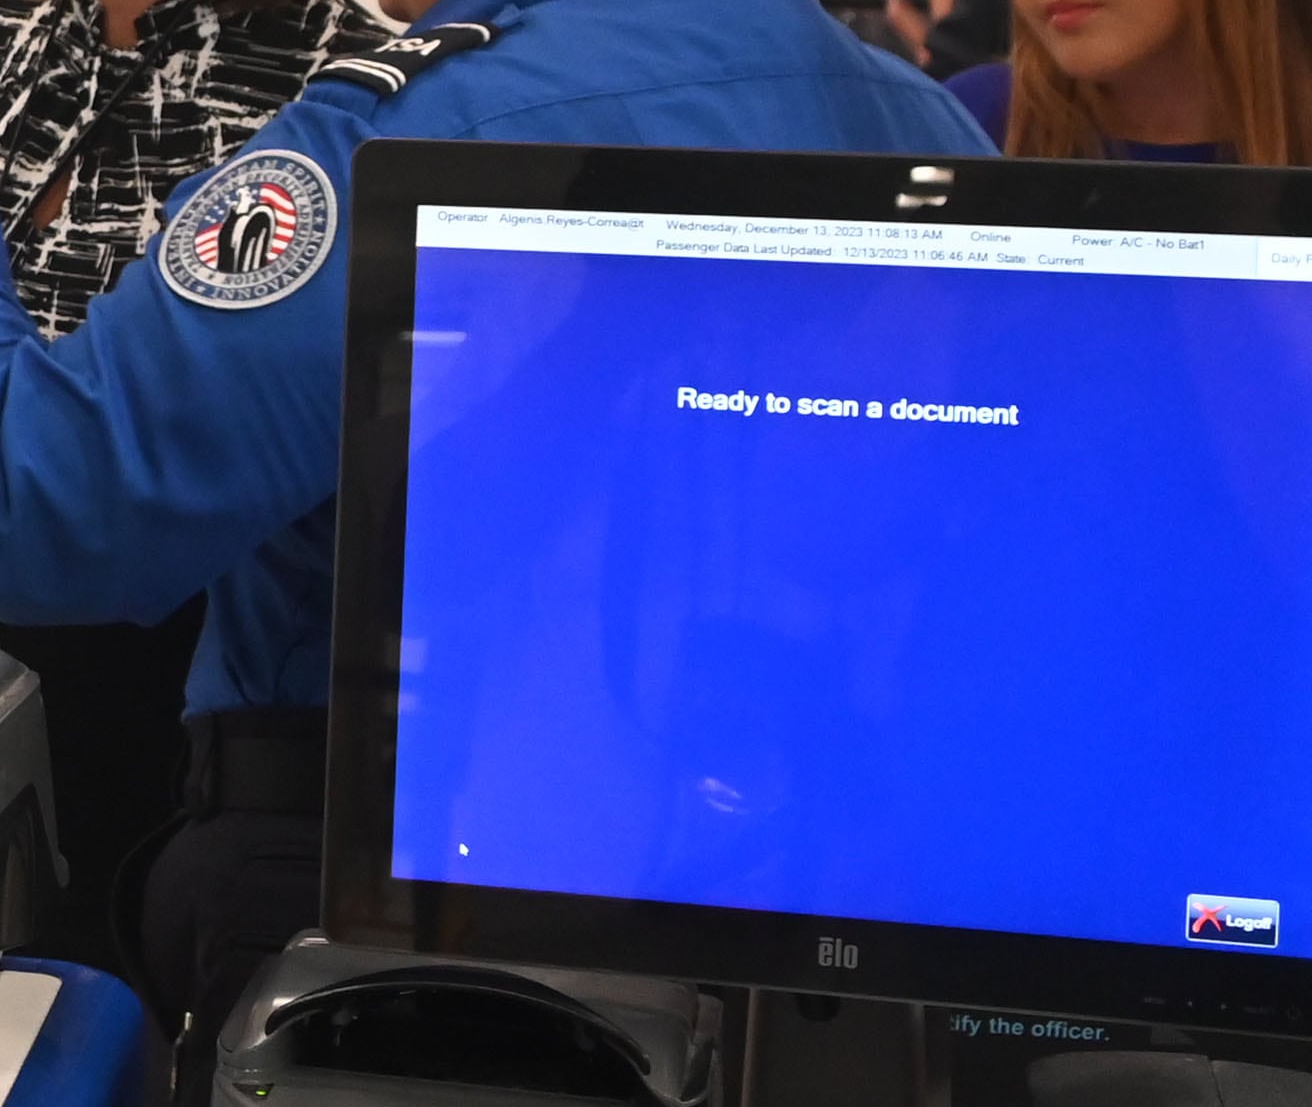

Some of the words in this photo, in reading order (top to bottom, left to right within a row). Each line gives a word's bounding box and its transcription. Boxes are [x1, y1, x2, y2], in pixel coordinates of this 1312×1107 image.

[745, 223, 809, 236] December
[834, 226, 864, 238] 2023
[921, 230, 943, 241] AM
[970, 230, 1012, 243] Online
[1120, 236, 1143, 249] A/C
[1156, 238, 1174, 250] No
[210, 229, 326, 301] INNOVATION
[656, 239, 720, 255] Passenger
[723, 242, 750, 254] Data
[753, 243, 778, 255] Last
[843, 247, 908, 260] 12/13/2023
[967, 251, 989, 263] AM
[1037, 253, 1085, 267] Current
[1272, 253, 1302, 268] Daily
[677, 387, 759, 416] Ready
[765, 392, 791, 414] to
[797, 396, 859, 418] scan
[866, 400, 883, 419] a
[890, 398, 1020, 426] document
[1226, 914, 1273, 932] Logoff
[989, 1017, 1024, 1036] the
[1031, 1020, 1110, 1042] officer.
